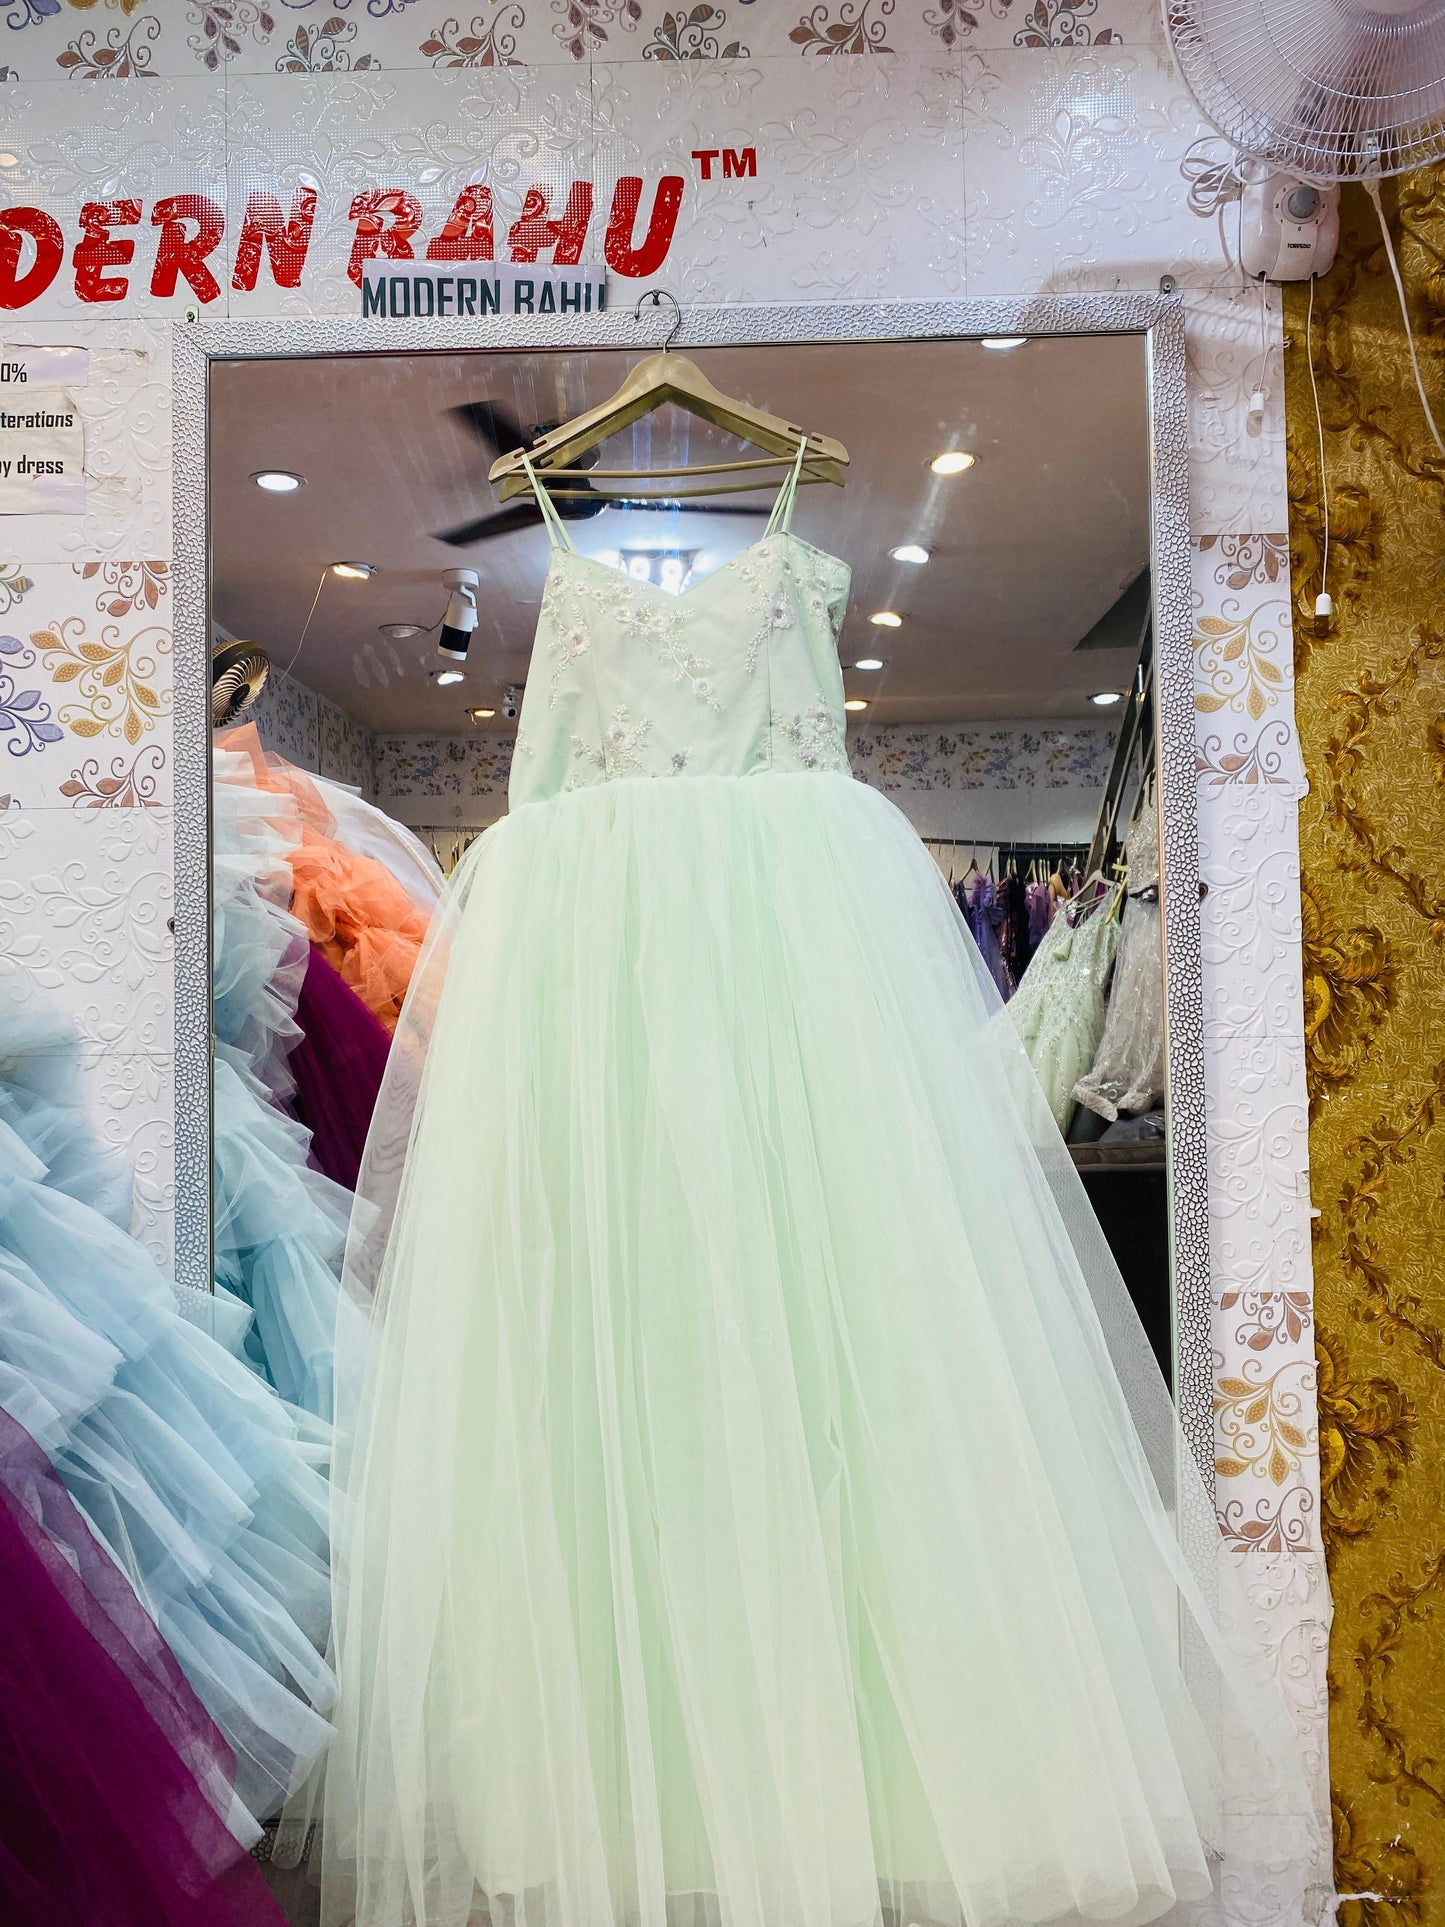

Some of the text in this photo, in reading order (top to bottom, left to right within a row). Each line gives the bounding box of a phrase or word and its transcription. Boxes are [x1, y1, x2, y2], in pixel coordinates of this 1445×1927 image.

[347, 175, 685, 289] RAHU
[692, 147, 758, 180] TM
[362, 277, 501, 318] MODERN
[17, 454, 64, 474] dress
